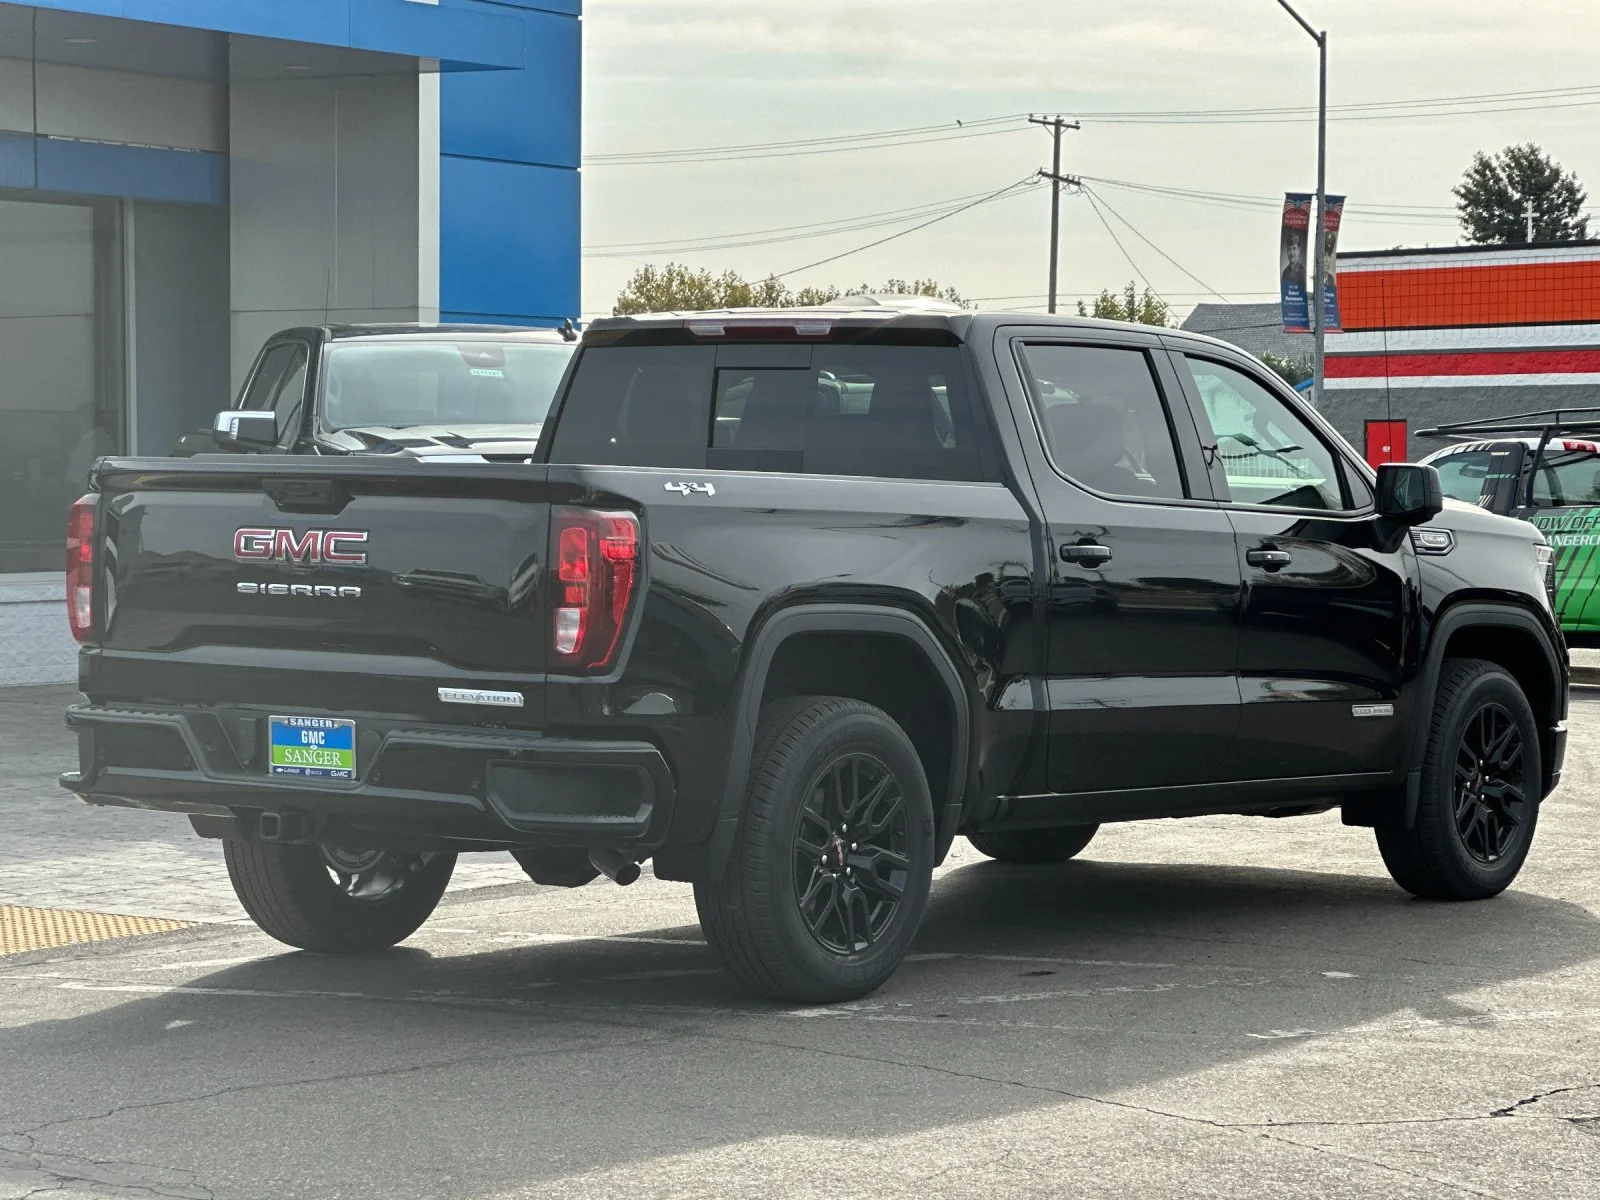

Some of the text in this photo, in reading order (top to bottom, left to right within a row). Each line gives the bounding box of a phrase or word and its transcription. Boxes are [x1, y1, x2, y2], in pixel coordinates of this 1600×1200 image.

[1528, 516, 1568, 530] NOW
[234, 528, 368, 563] GMC
[1546, 535, 1600, 546] ANGERC
[237, 582, 361, 597] SIERRA
[444, 692, 517, 703] ELEVATION
[289, 718, 333, 728] SANGER
[301, 730, 325, 745] GMC
[285, 749, 343, 766] SANGER
